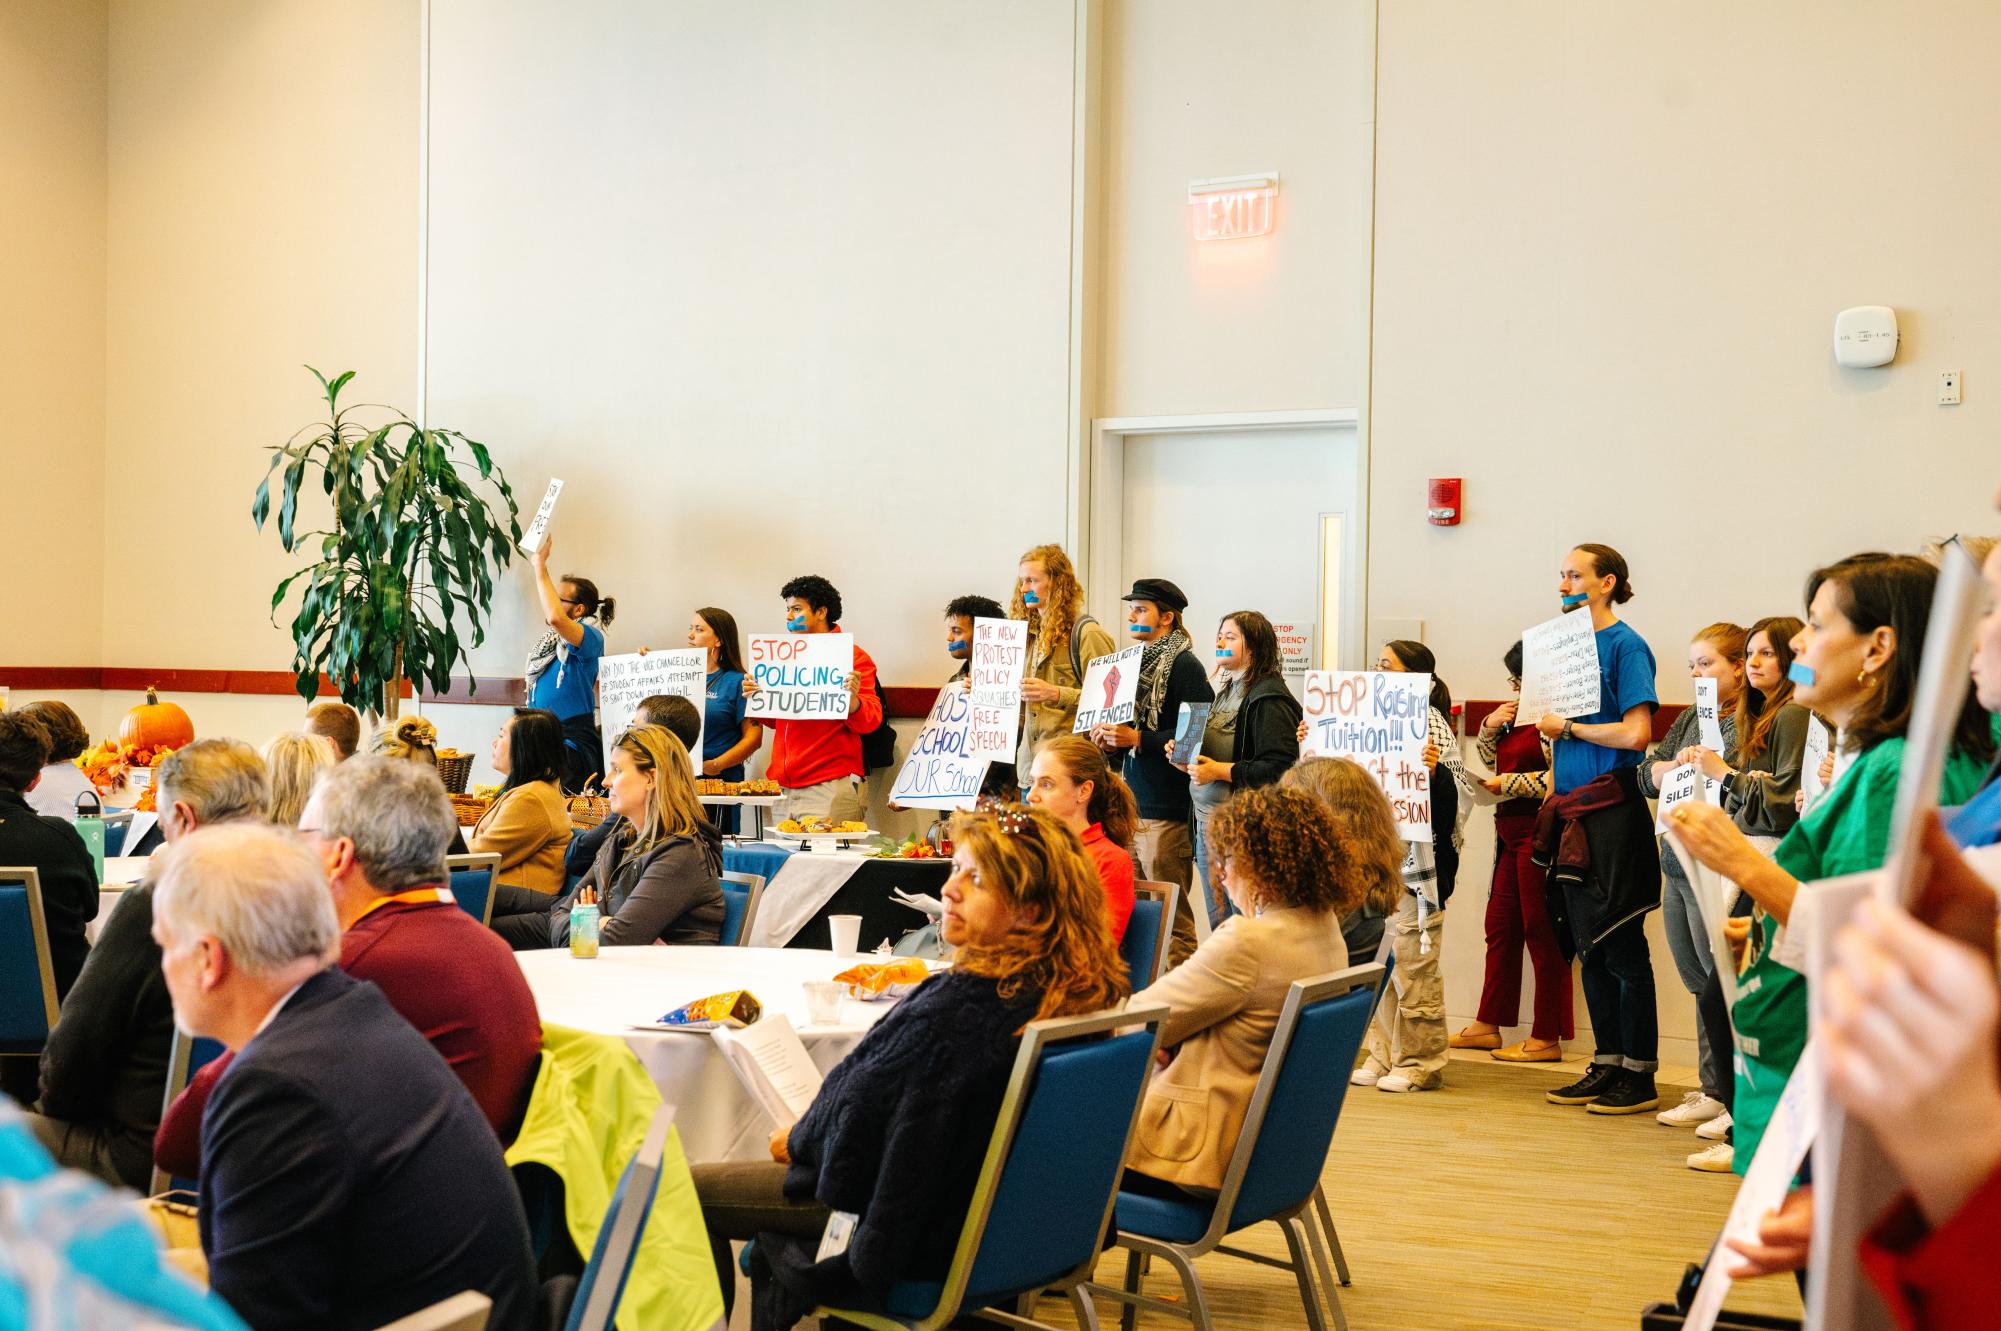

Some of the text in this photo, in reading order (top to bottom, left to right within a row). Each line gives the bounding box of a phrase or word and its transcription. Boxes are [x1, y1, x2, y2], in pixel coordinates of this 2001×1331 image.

[1206, 191, 1259, 236] EXIT
[976, 624, 1018, 641] THE NEW
[1273, 625, 1295, 633] STOP
[752, 639, 807, 661] STOP
[974, 643, 1023, 667] PROTEST
[1090, 657, 1102, 668] WE
[1102, 652, 1120, 665] WILL
[1120, 647, 1134, 660] NOT
[1282, 647, 1303, 655] ONLY
[613, 662, 625, 677] DID
[628, 661, 640, 674] THE
[643, 659, 655, 672] VICE
[656, 656, 702, 670] CHANCELLOR
[754, 663, 844, 689] POLICING
[973, 668, 1010, 687] POLICY
[609, 678, 635, 691] STUDENT
[637, 675, 665, 687] AFFAIRS
[668, 671, 703, 683] ATTEMPT
[601, 695, 609, 705] TO
[609, 690, 624, 705] SHUT
[625, 689, 645, 701] DOWN
[751, 690, 847, 713] STUDENTS
[971, 688, 1017, 707] SQUASHES
[1373, 673, 1428, 740] Raising
[973, 707, 1000, 731] FREE
[1075, 701, 1134, 731] SILENCED
[912, 724, 970, 758] SCHOOL
[969, 731, 1007, 752] SPEECH
[1317, 717, 1403, 753] Tuition!!!
[899, 758, 985, 795] OUR School
[1396, 760, 1429, 791] the
